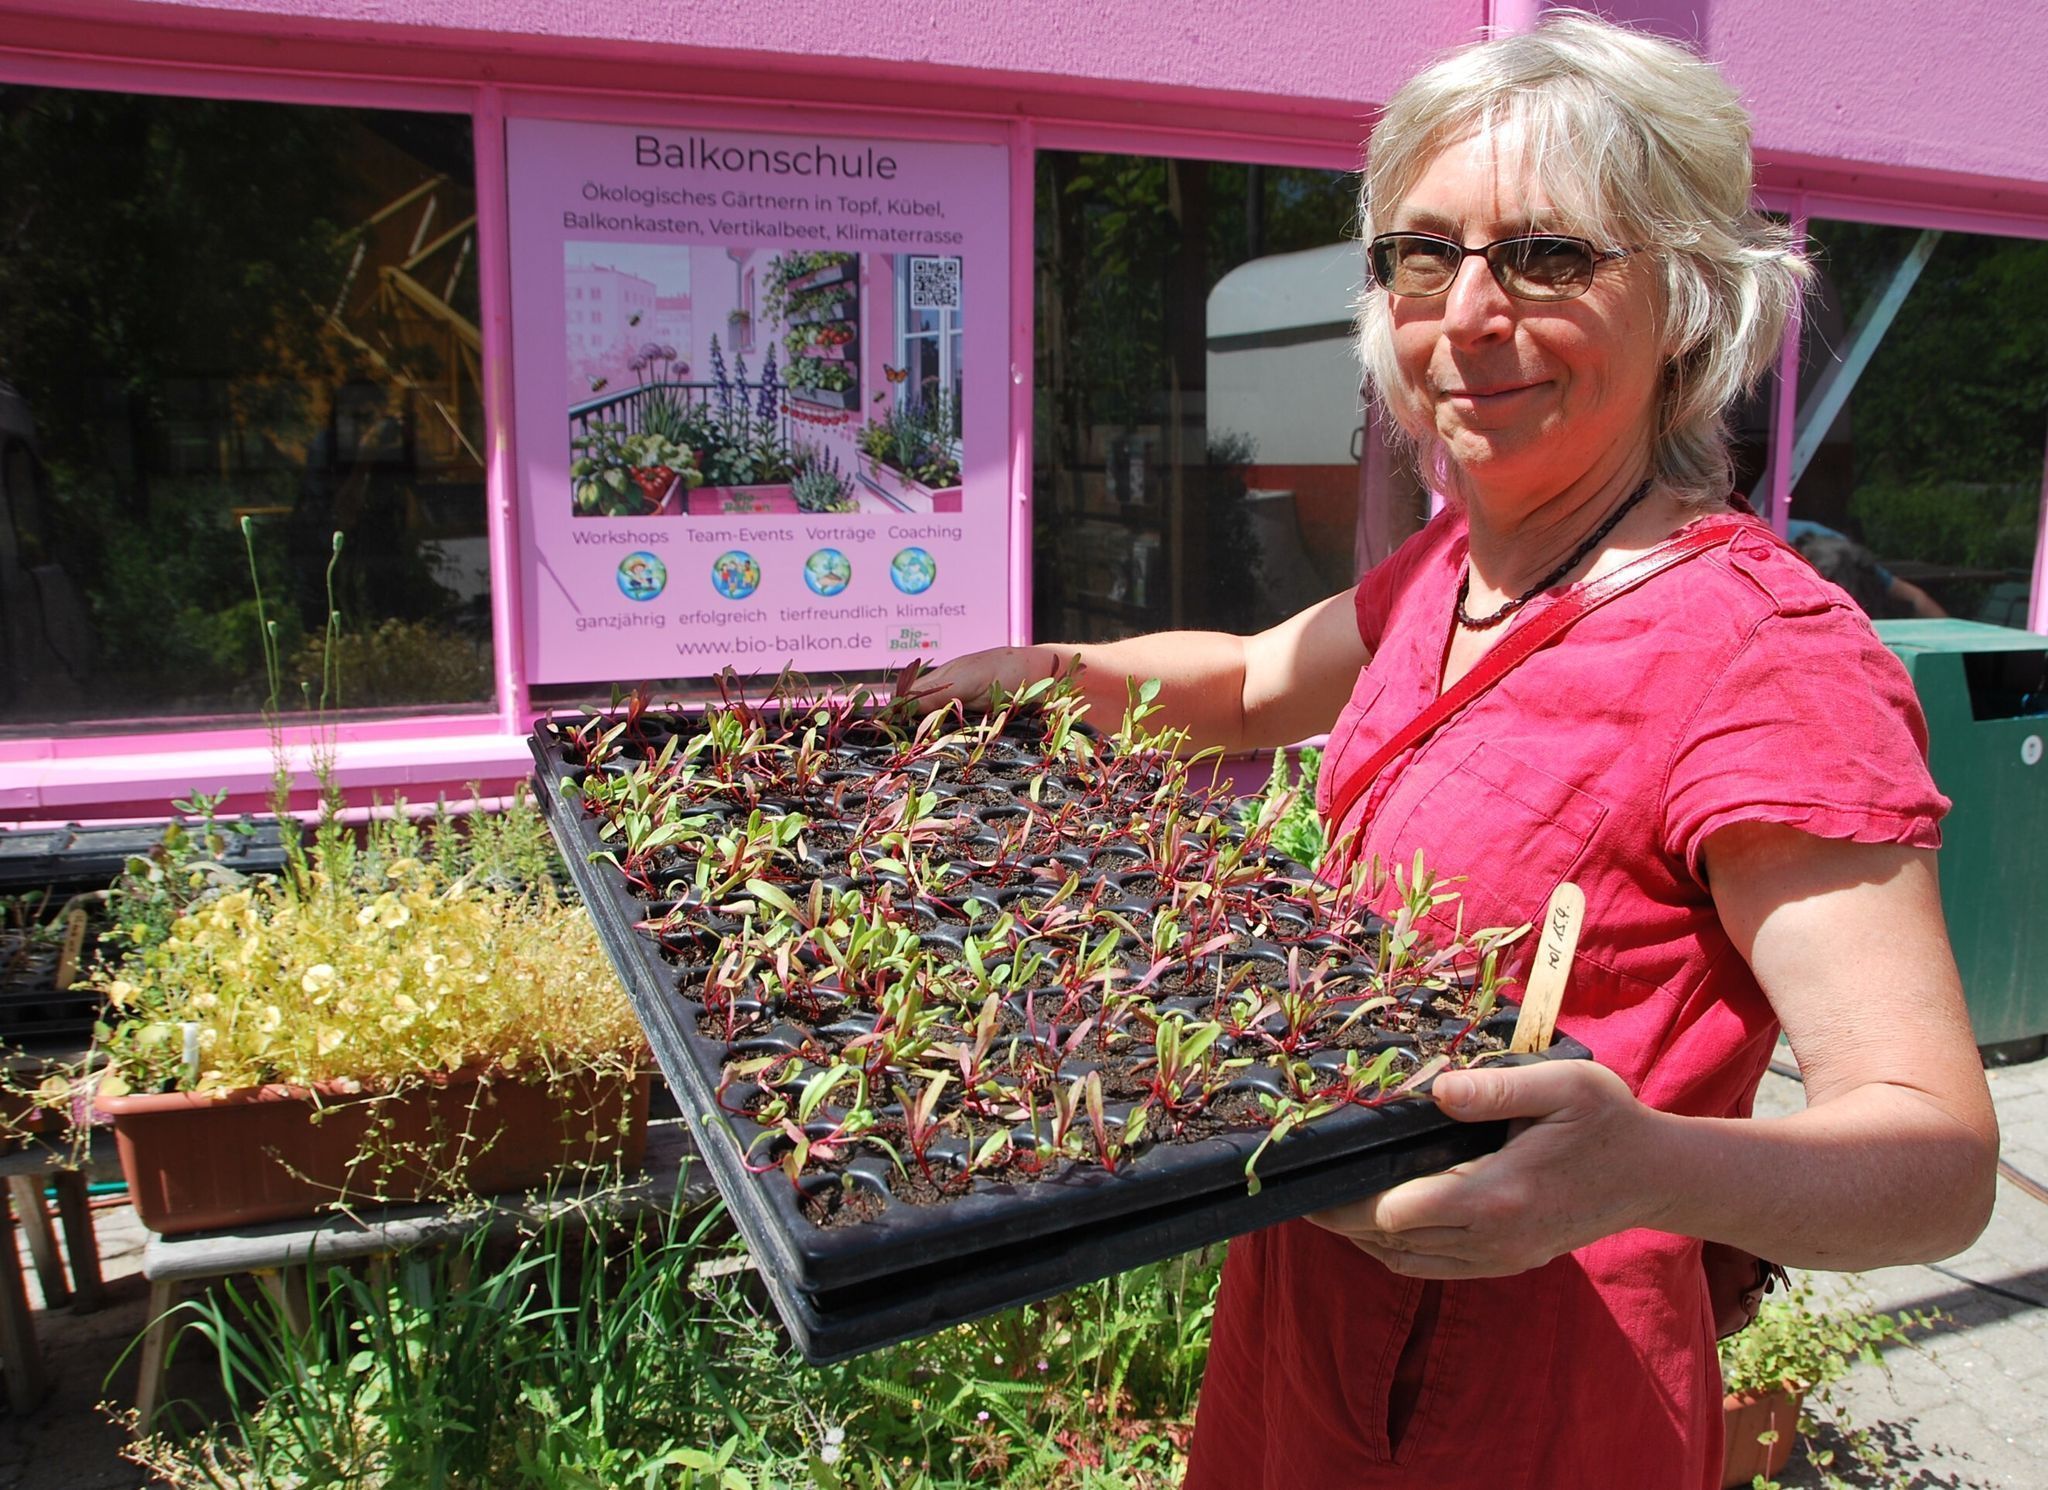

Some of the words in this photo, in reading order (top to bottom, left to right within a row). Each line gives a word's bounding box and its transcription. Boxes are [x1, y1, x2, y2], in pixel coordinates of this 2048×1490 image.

[634, 135, 898, 180] Balkonschule
[581, 182, 716, 208] Ökologisches
[721, 190, 809, 211] Gärtnern
[815, 196, 832, 212] in
[837, 196, 882, 216] Topf,
[887, 200, 945, 219] Kübel,
[563, 212, 704, 236] Balkonkasten,
[708, 218, 831, 241] Vertikalbeet,
[836, 224, 964, 245] Klimaterrasse
[573, 530, 669, 546] Workshops
[687, 528, 794, 543] Team-Events
[806, 526, 876, 544] Vorträge
[888, 525, 963, 542] Coaching
[576, 612, 665, 632] ganzjährig
[679, 607, 767, 627] erfolgreich
[780, 604, 887, 623] tierfreundlich
[897, 602, 966, 619] klimafest
[676, 633, 872, 655] www.bio-balkon.de
[890, 639, 938, 649] Balkon
[900, 627, 929, 639] Bio-
